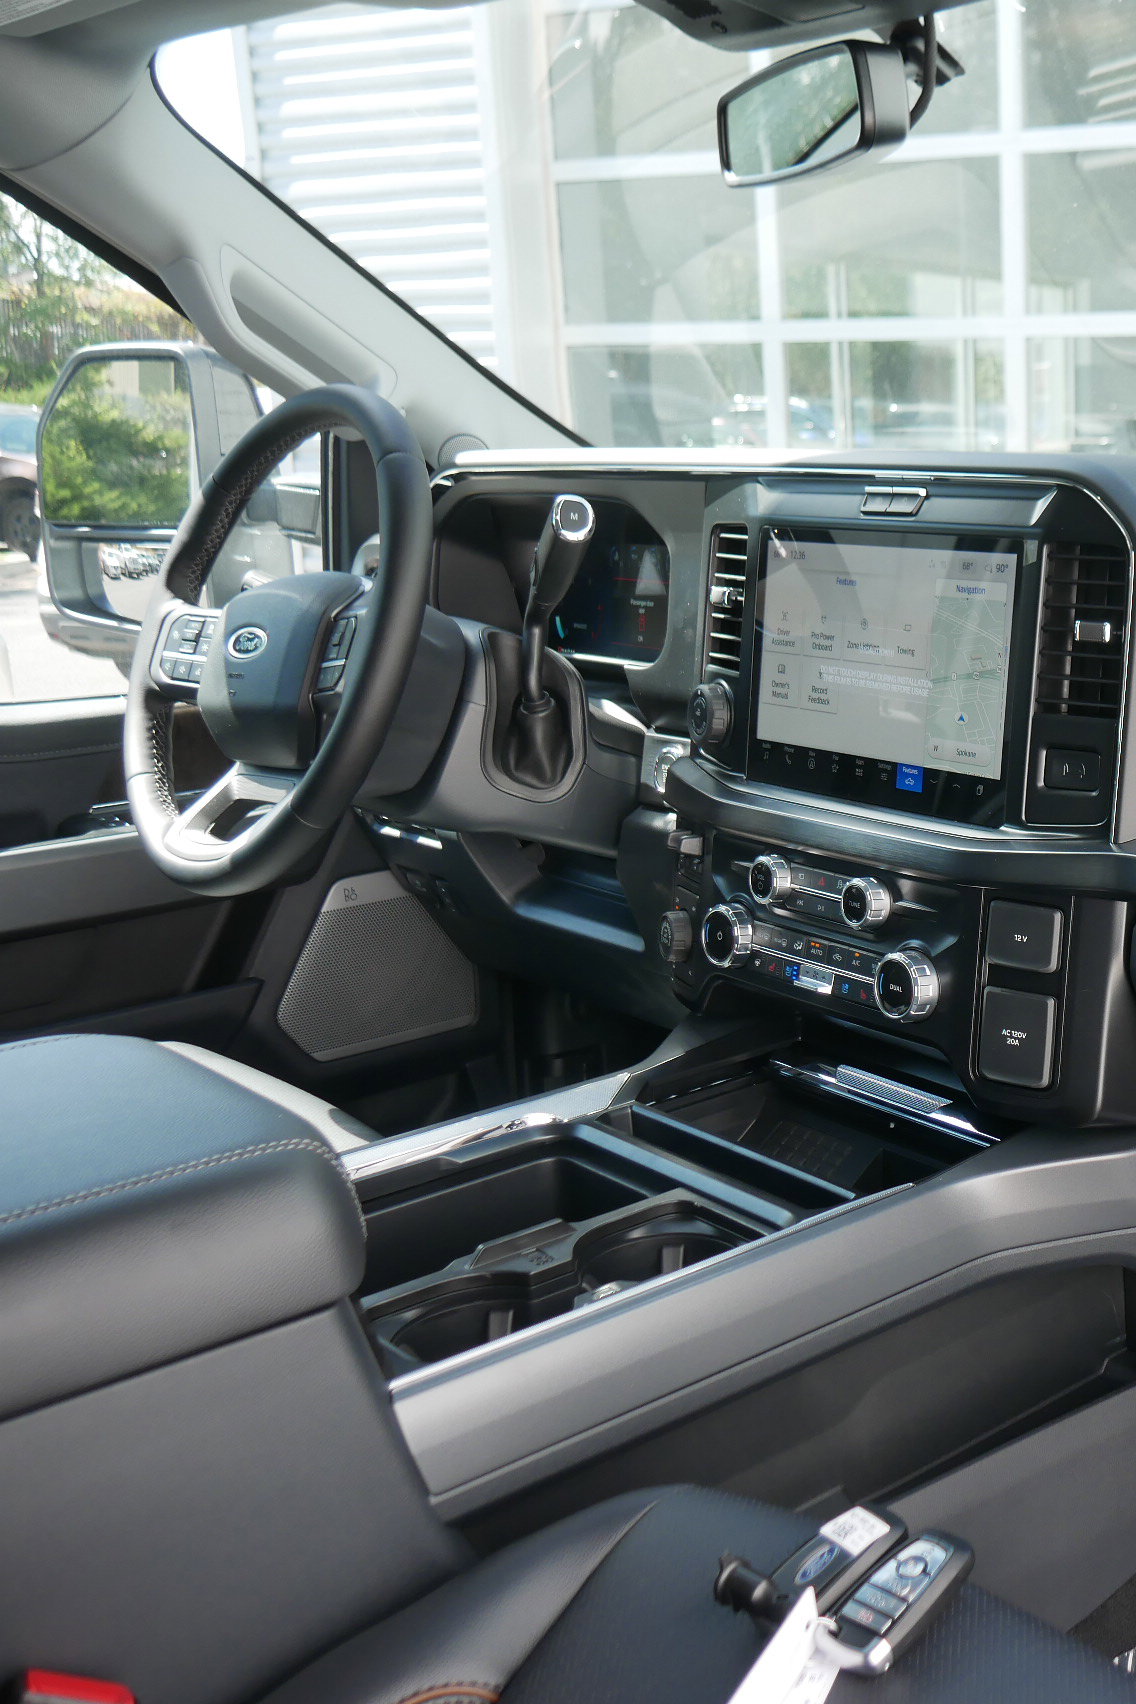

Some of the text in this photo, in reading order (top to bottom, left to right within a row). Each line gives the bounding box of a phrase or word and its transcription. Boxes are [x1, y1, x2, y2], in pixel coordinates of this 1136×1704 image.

[570, 512, 578, 520] M
[836, 577, 857, 587] Features
[956, 584, 986, 596] Navigation
[777, 628, 790, 637] Driver
[811, 632, 835, 642] Pro Power
[771, 638, 796, 649] Assistance
[812, 642, 833, 652] Onboard
[847, 640, 859, 649] Zone
[772, 680, 790, 690] Owner's
[811, 685, 828, 695] Record
[772, 691, 788, 700] Manual
[808, 695, 830, 706] Feedback
[956, 748, 977, 759] Spokane
[849, 900, 861, 909] TUNE
[810, 948, 823, 956] AUTO
[890, 984, 903, 993] DUAL
[1002, 1028, 1027, 1039] AC 120V
[1007, 1038, 1020, 1046] 20A
